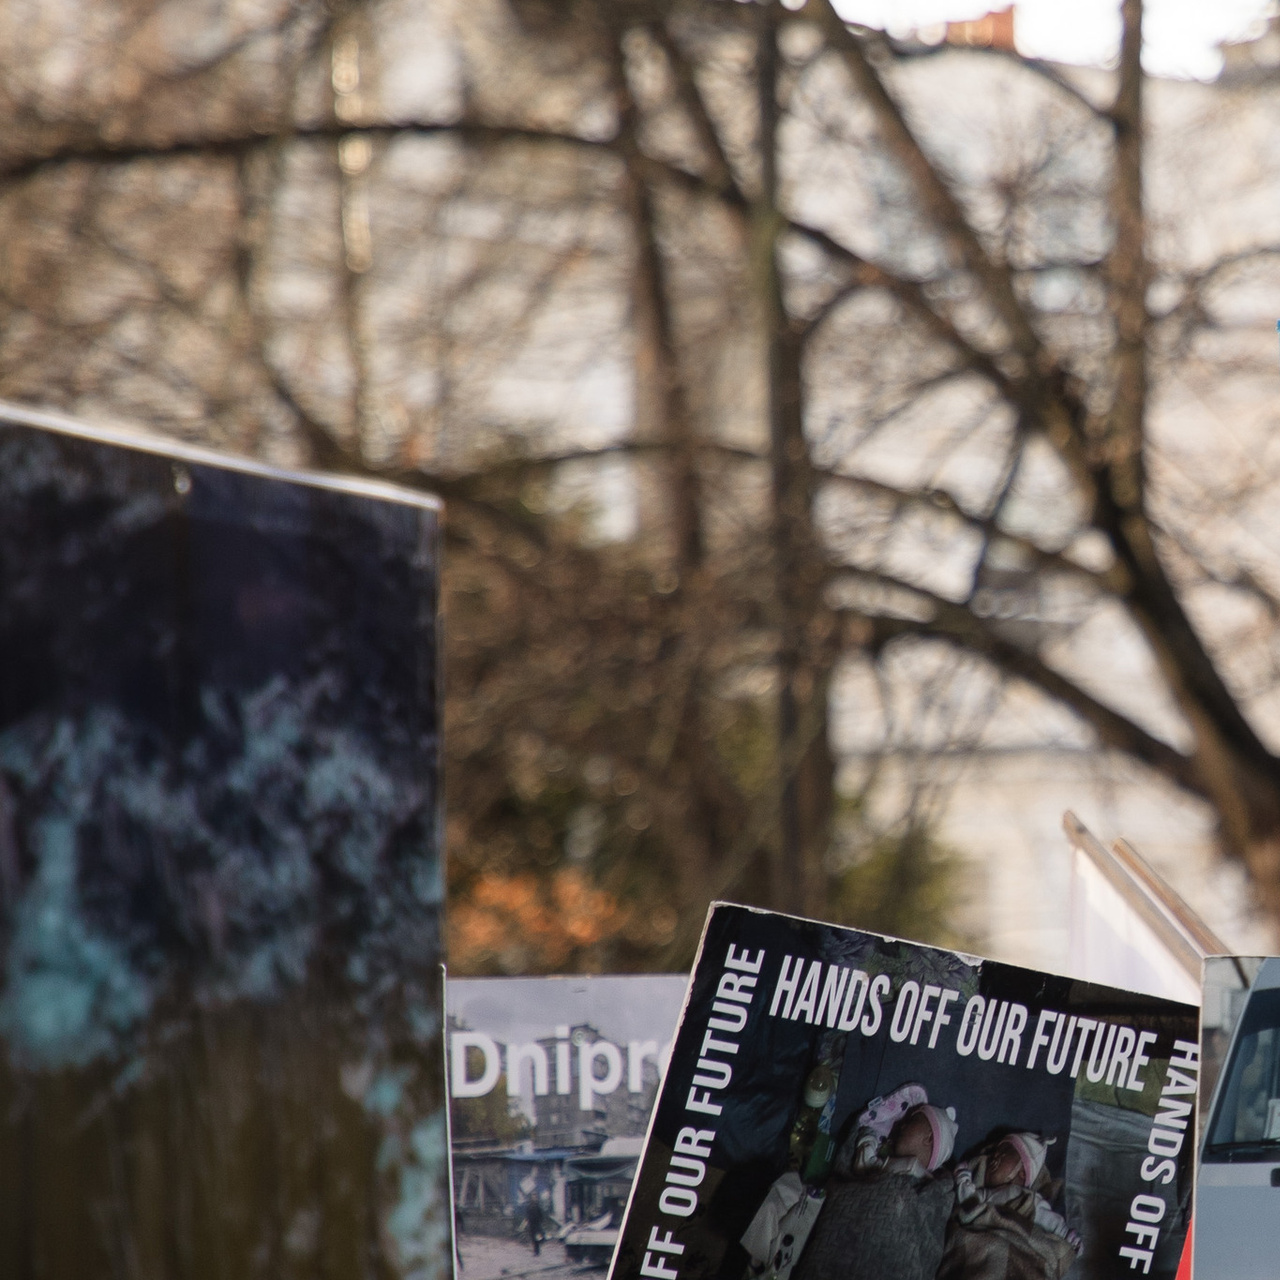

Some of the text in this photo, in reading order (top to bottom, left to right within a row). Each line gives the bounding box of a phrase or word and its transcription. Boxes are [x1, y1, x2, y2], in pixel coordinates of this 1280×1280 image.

[684, 942, 766, 1117] FUTURE
[769, 955, 1159, 1093] HANDS OFF OUR FUTURE
[658, 1126, 717, 1218] OUR
[1139, 1038, 1200, 1186] HANDS
[1117, 1194, 1167, 1275] OFF
